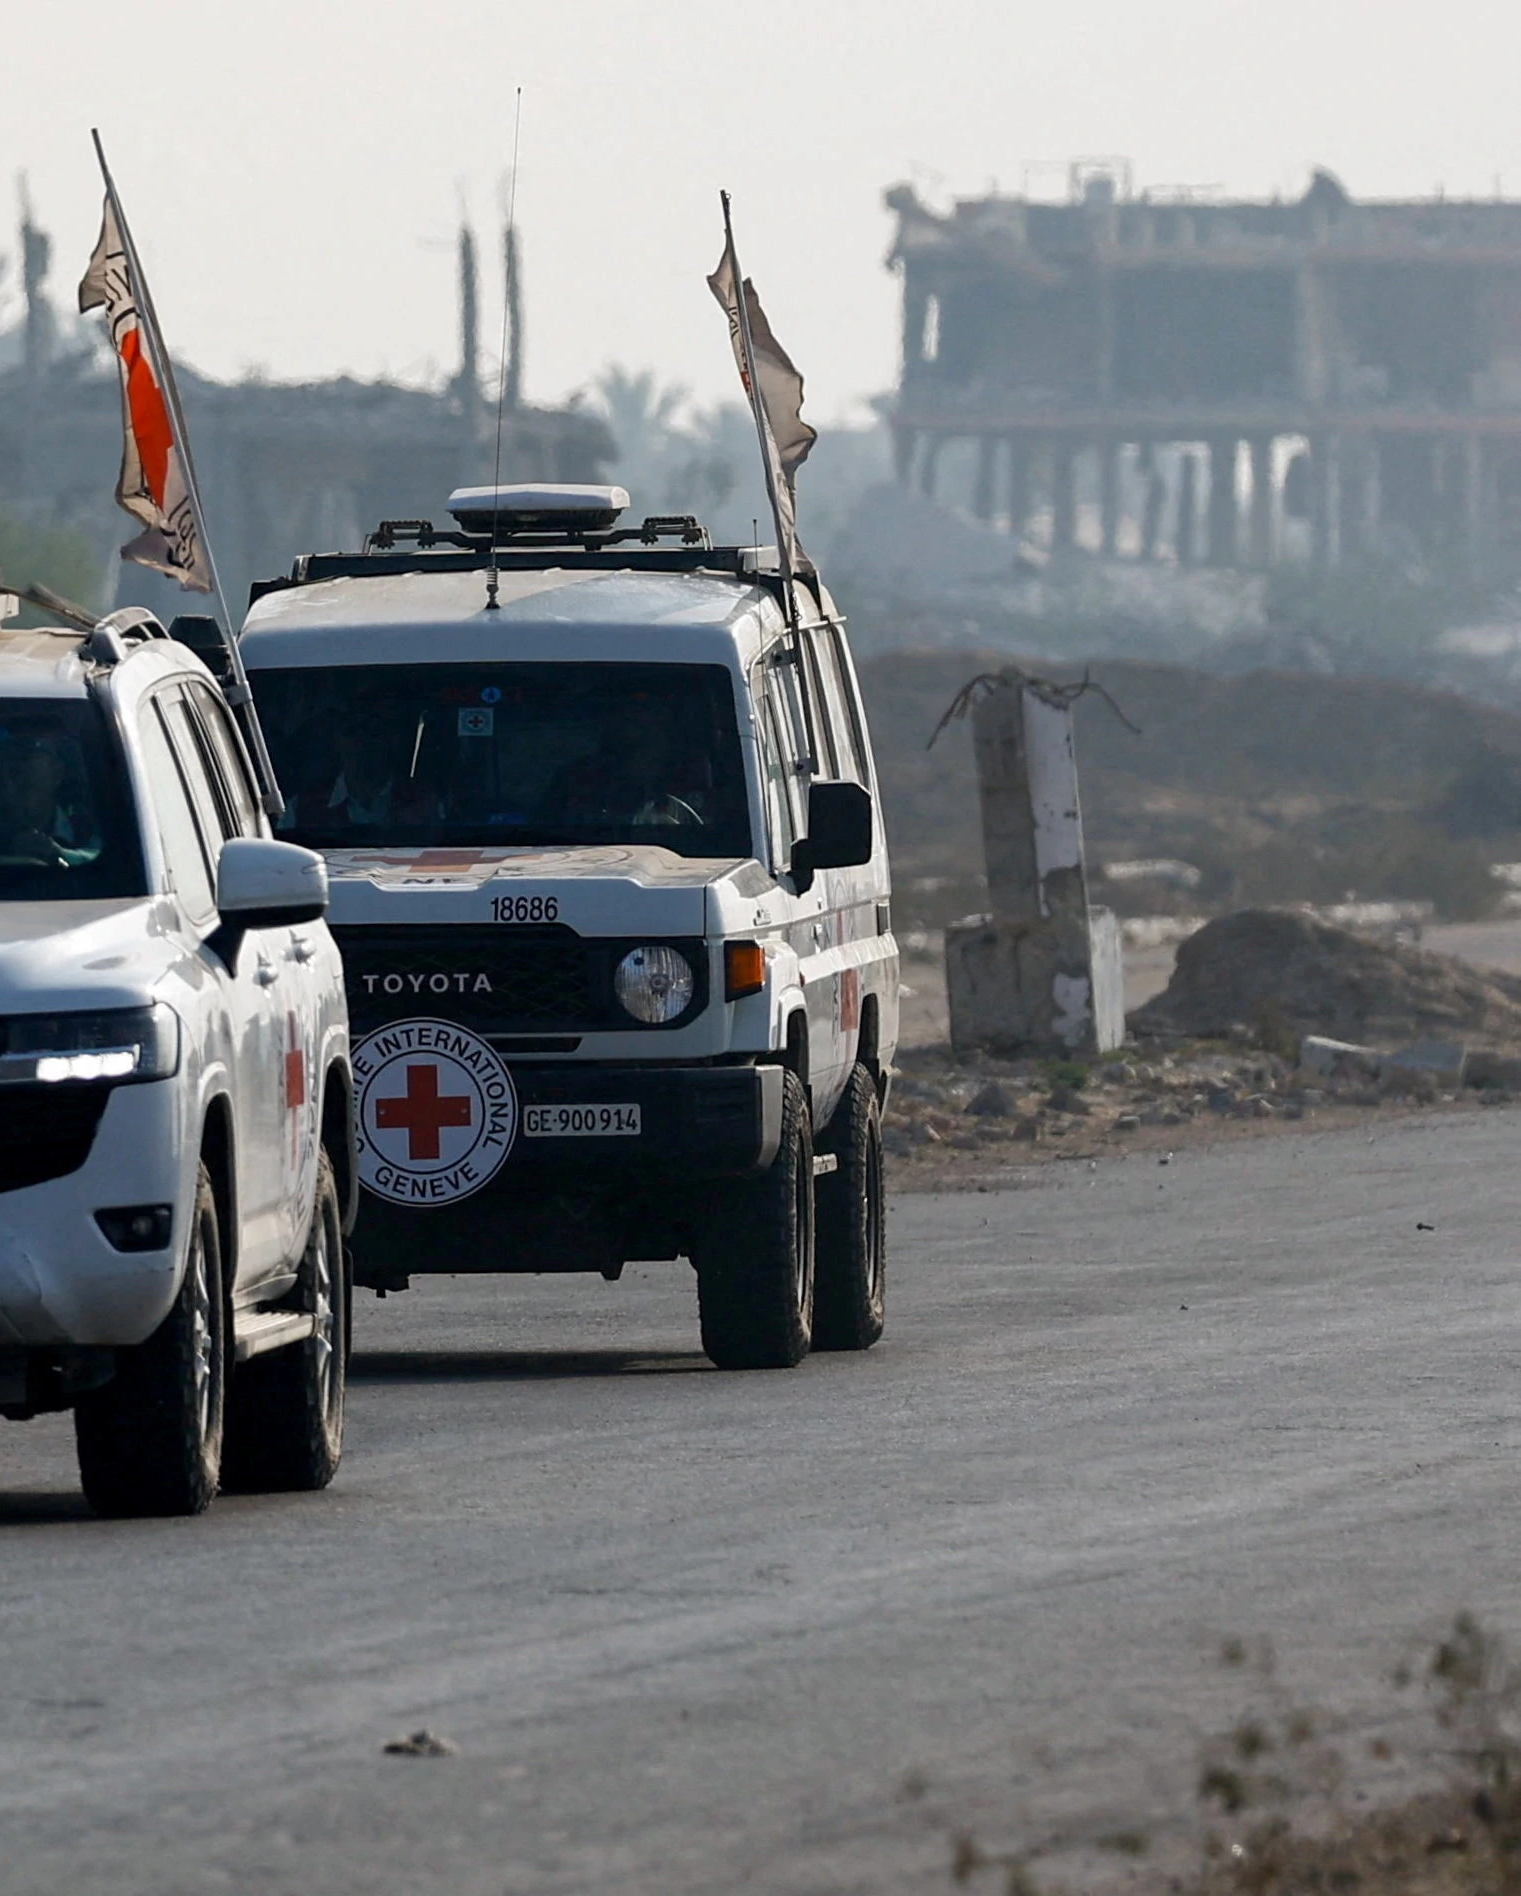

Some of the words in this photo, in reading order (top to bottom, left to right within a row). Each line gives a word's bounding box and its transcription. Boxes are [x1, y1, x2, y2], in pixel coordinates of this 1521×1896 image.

[491, 897, 558, 921] 18686
[362, 973, 493, 993] TOYOTA
[375, 1027, 509, 1149] INTERNATIONAL
[374, 1161, 479, 1198] GENEVE
